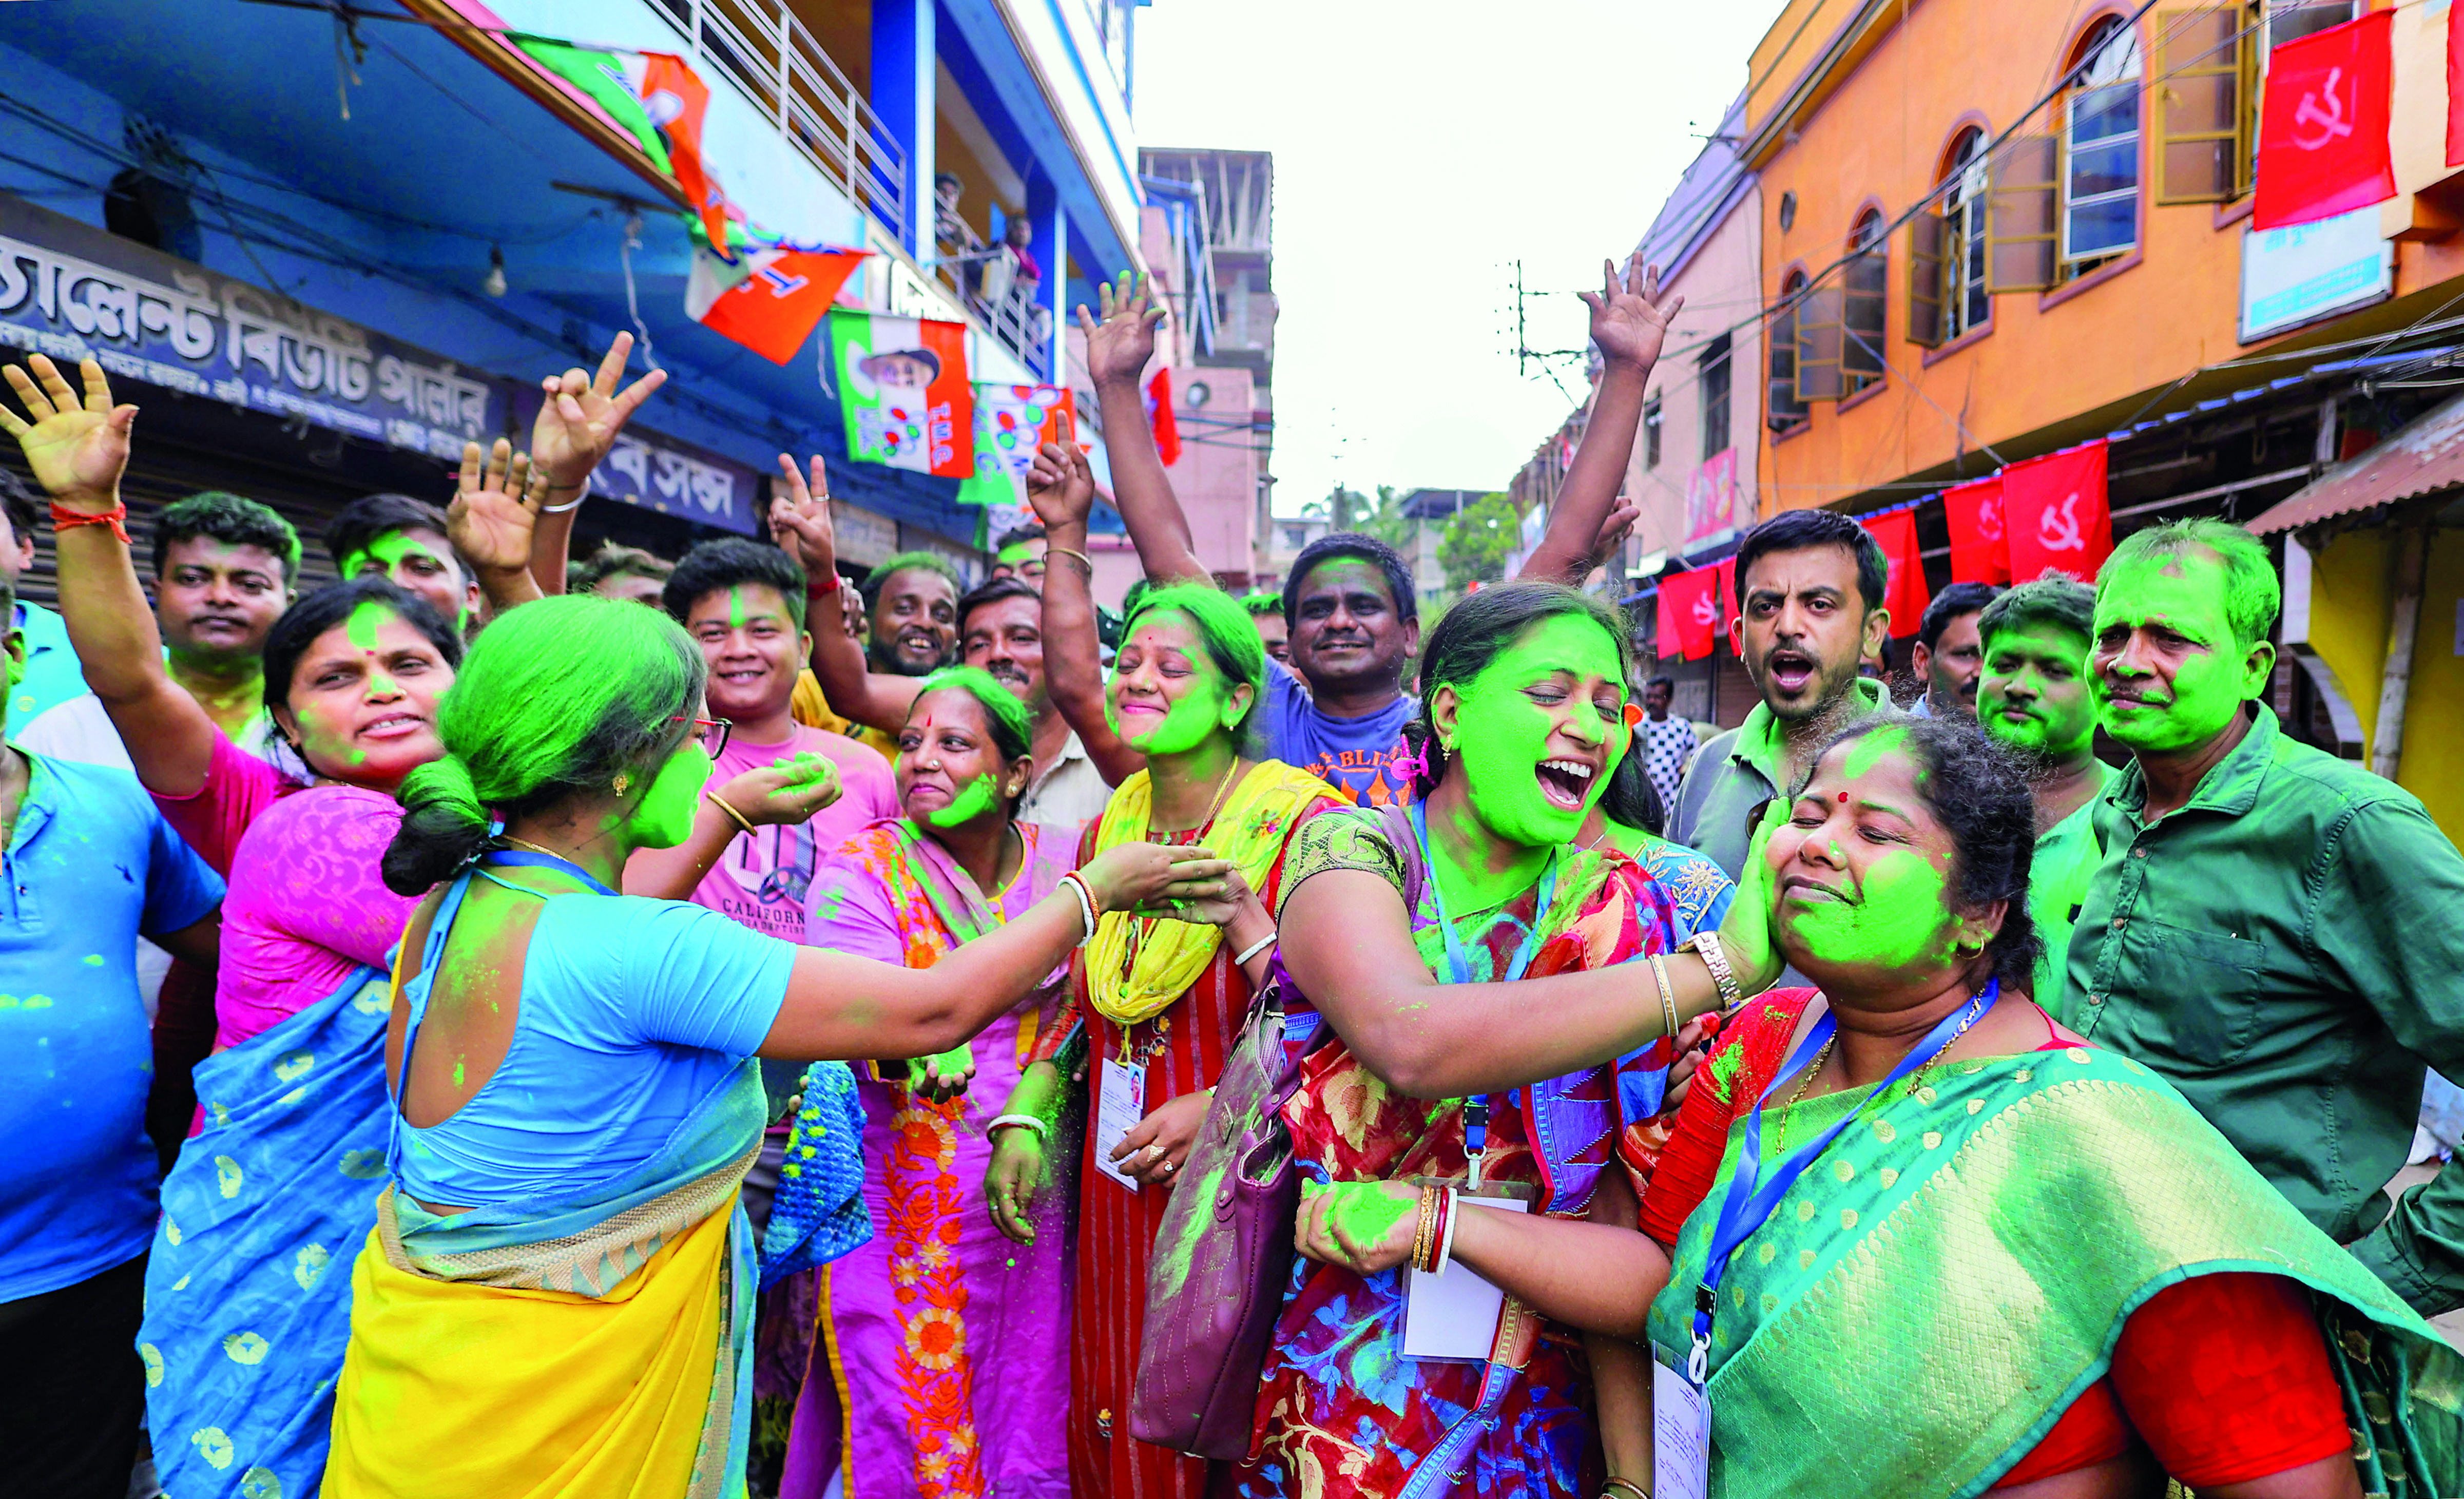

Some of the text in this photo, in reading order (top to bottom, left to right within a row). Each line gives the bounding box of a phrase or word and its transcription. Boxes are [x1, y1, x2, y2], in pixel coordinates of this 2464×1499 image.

[221, 284, 373, 401] বিউটি
[377, 354, 490, 438] পার্লার
[723, 898, 805, 925] CALIFORN
